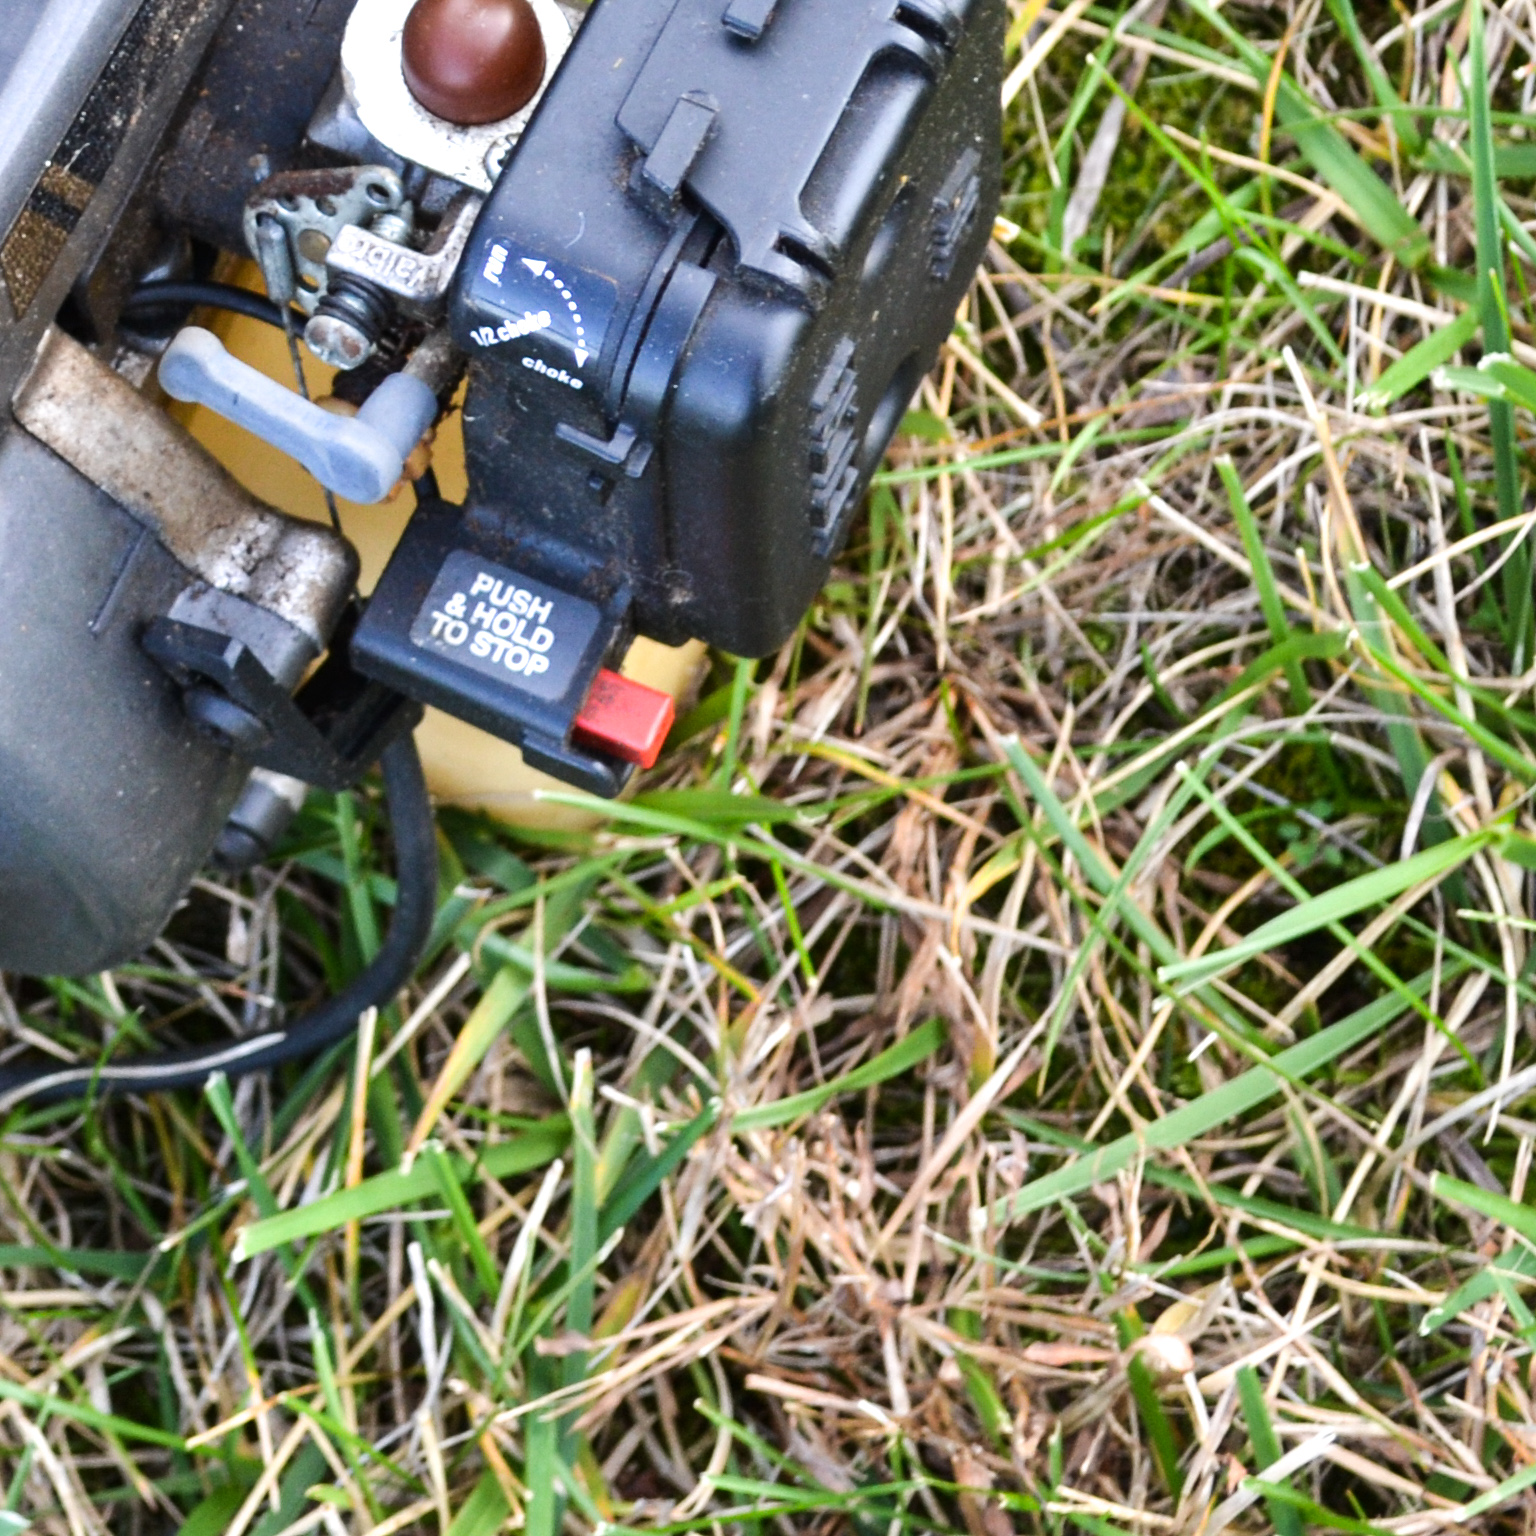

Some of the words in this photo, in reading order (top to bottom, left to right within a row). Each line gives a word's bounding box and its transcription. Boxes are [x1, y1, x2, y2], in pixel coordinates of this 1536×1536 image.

[483, 245, 508, 283] run
[470, 326, 499, 346] 1/2
[497, 310, 551, 341] choke
[522, 357, 583, 389] choke
[470, 572, 553, 624] PUSH
[431, 611, 469, 646] TO
[470, 631, 549, 676] STOP
[445, 592, 466, 617] &
[470, 601, 554, 652] HOLD
